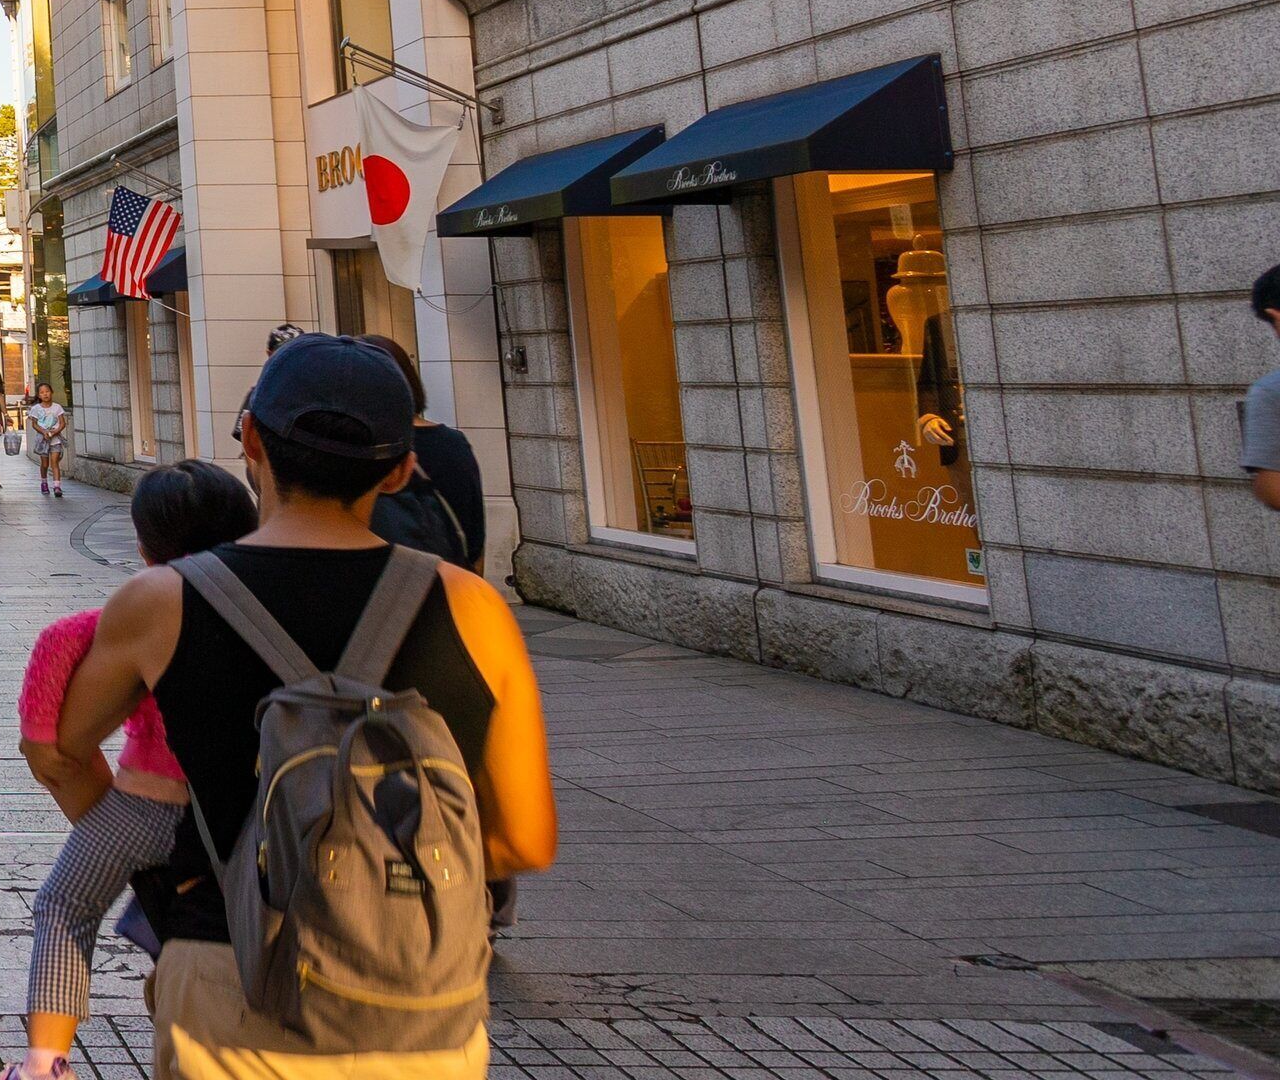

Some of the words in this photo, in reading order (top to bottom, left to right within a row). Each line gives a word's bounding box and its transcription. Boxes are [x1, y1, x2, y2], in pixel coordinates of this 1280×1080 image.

[666, 166, 698, 192] Brooks
[698, 160, 737, 186] Brothers
[840, 478, 905, 519] Brooks
